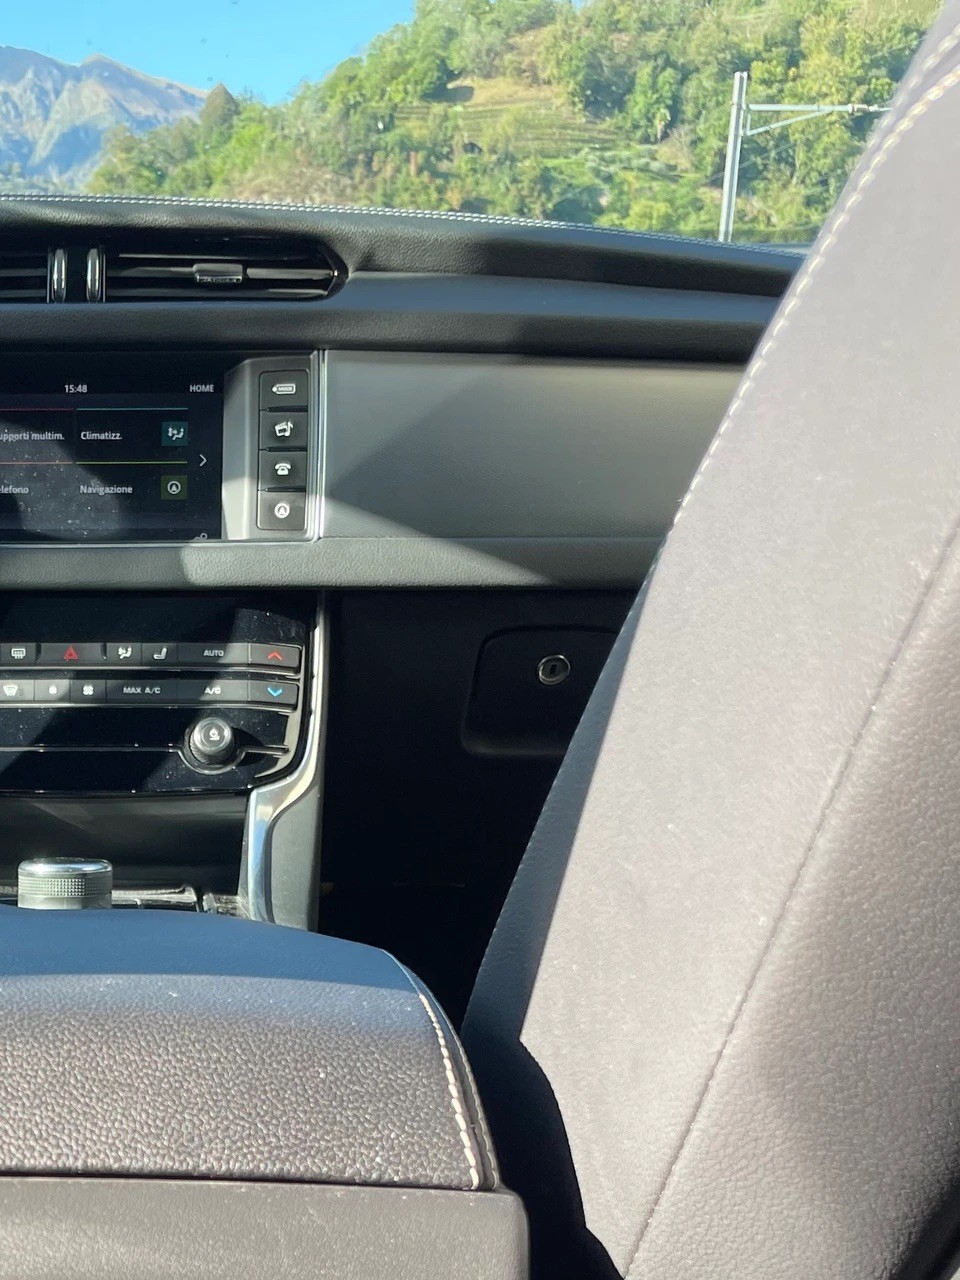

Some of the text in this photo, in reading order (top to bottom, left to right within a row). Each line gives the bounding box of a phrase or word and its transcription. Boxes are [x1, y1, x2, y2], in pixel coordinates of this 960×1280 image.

[64, 384, 88, 393] 15:48
[189, 384, 215, 393] HOME
[31, 431, 65, 441] multim.
[80, 431, 123, 441] Climatizz.
[80, 484, 133, 496] Navigazione
[203, 649, 225, 658] AUTO
[122, 686, 161, 695] MAX A/C
[204, 686, 222, 695] A/C
